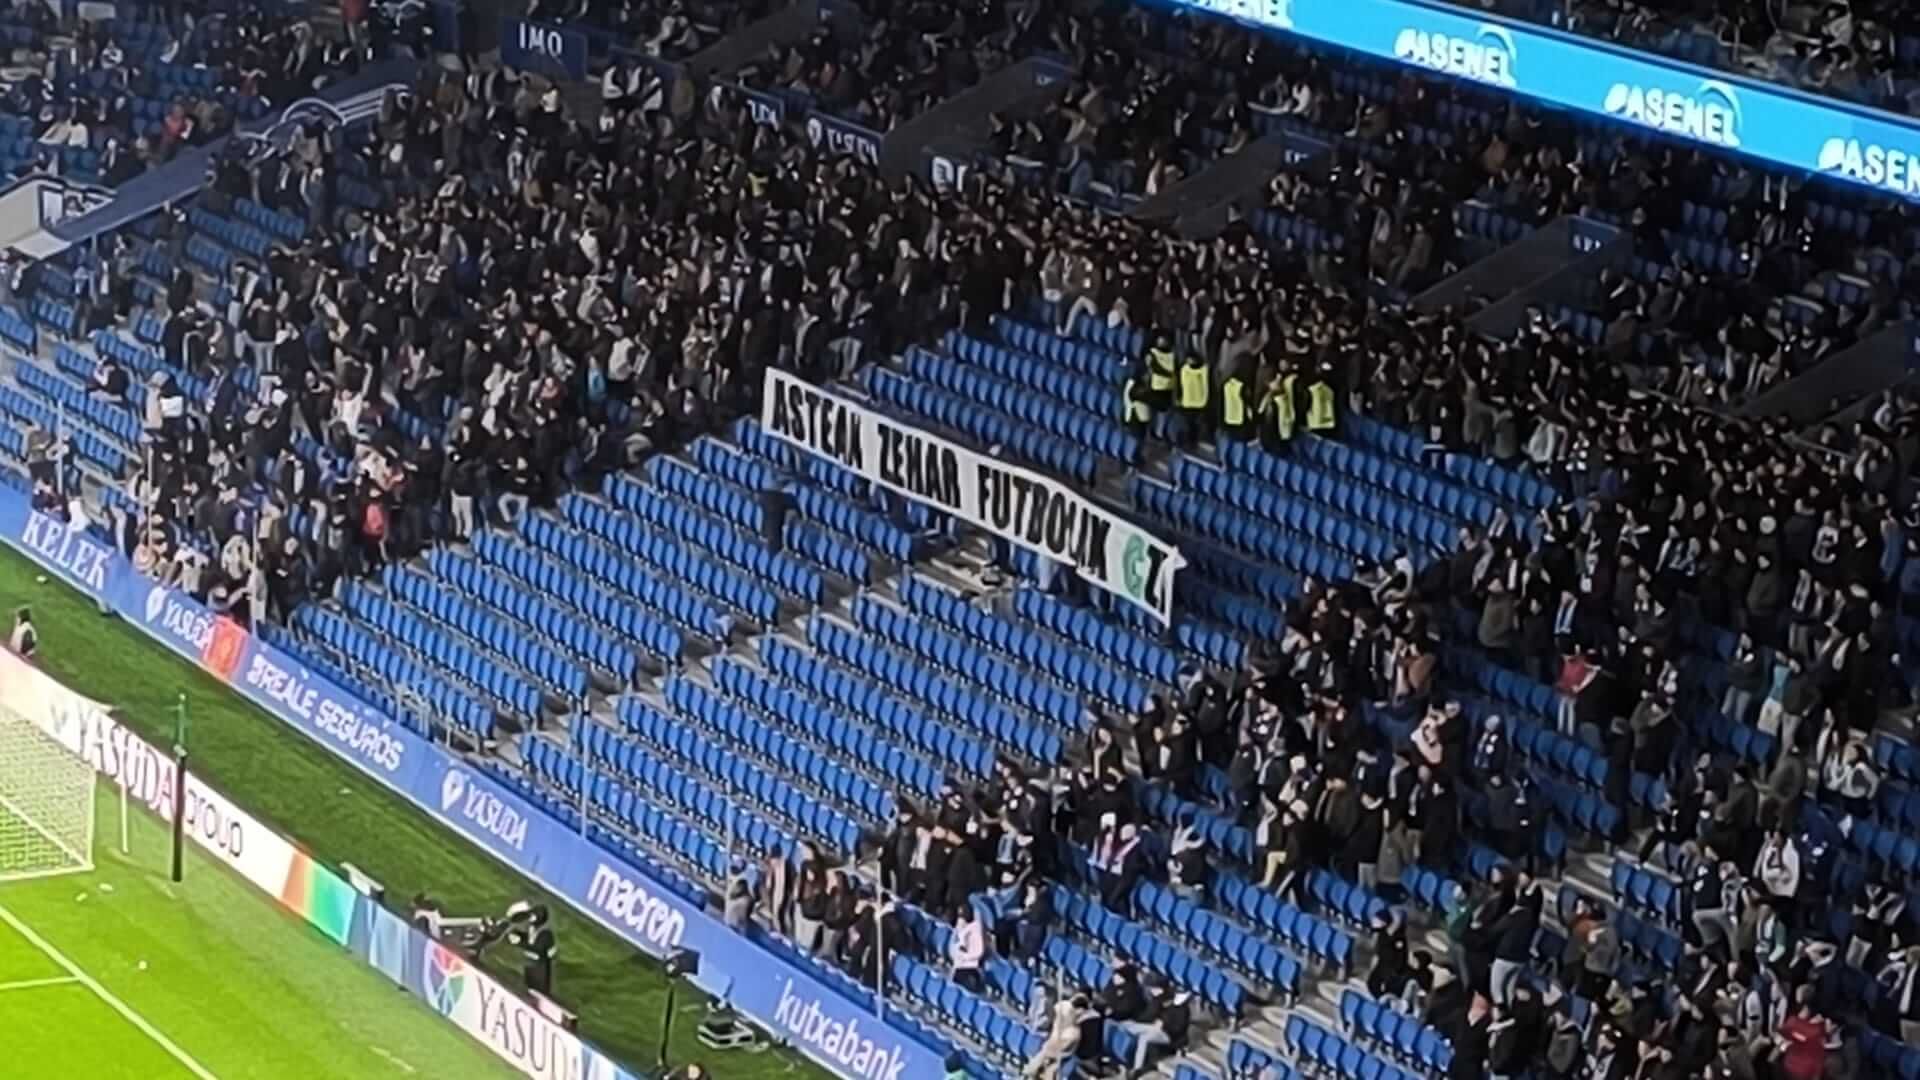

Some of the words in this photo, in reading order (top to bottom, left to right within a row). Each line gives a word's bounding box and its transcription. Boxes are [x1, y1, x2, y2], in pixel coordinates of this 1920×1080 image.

[877, 422, 961, 509] ZEHAR
[258, 668, 318, 720] REALE
[314, 698, 404, 771] SEGUROS
[463, 782, 528, 850] YASUDA
[588, 863, 686, 946] macron
[774, 978, 905, 1080] kutxabank
